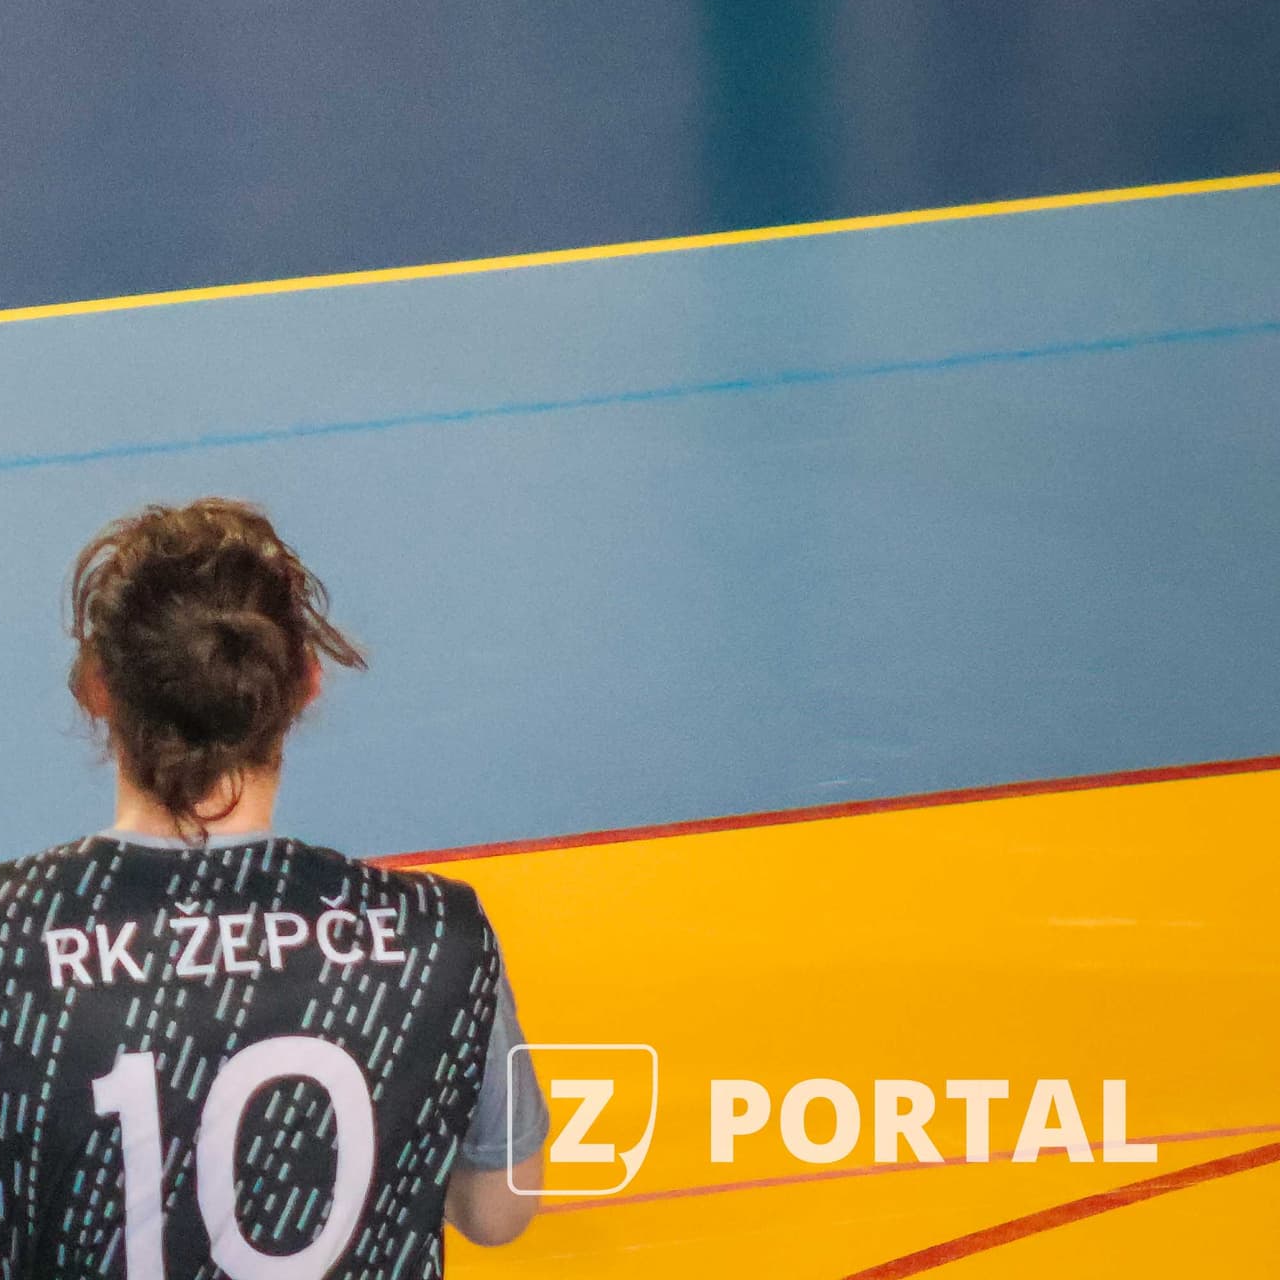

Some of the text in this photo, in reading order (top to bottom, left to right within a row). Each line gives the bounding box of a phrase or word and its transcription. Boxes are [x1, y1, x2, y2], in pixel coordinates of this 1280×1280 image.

[45, 895, 406, 989] RK ŽEPČE
[92, 1035, 375, 1280] 10
